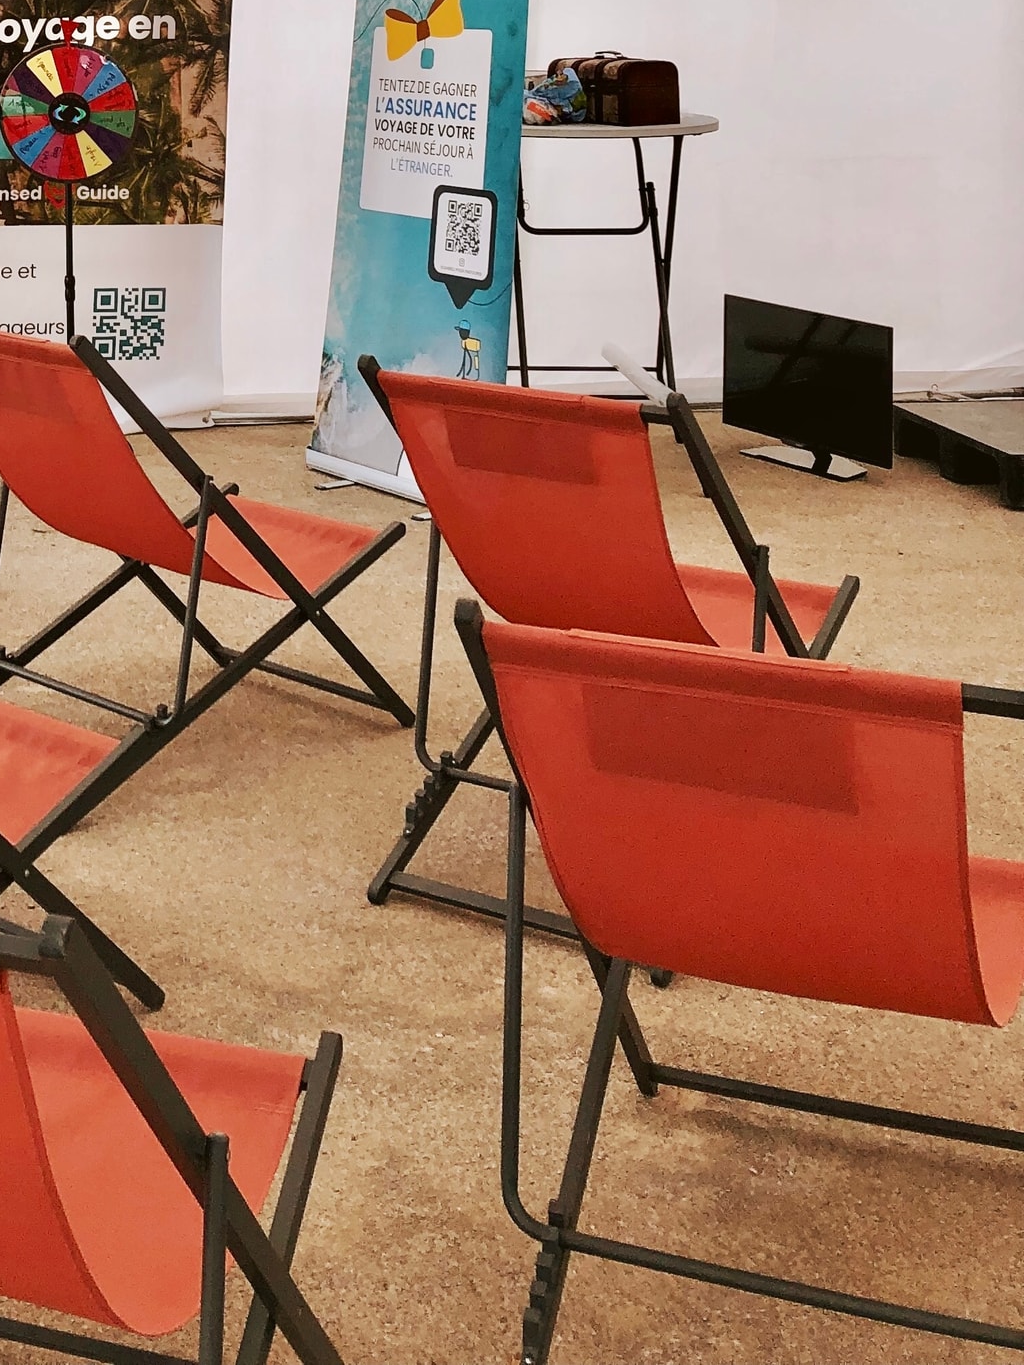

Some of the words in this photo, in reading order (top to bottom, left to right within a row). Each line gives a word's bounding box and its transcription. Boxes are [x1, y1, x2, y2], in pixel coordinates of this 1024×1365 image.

[128, 14, 177, 40] en
[378, 78, 416, 94] TENTEZ
[417, 80, 431, 95] DE
[433, 82, 478, 98] GAGNER
[375, 96, 478, 121] L'ASSURANCE
[374, 118, 418, 135] VOYAGE
[420, 123, 435, 137] DE
[437, 124, 476, 140] VOTRE
[372, 137, 421, 154] PROCHAIN
[423, 140, 465, 159] SÉJOUR
[466, 144, 474, 160] À
[390, 155, 454, 178] L'ÉTRANGER.
[76, 185, 130, 201] Guide
[17, 263, 37, 280] et
